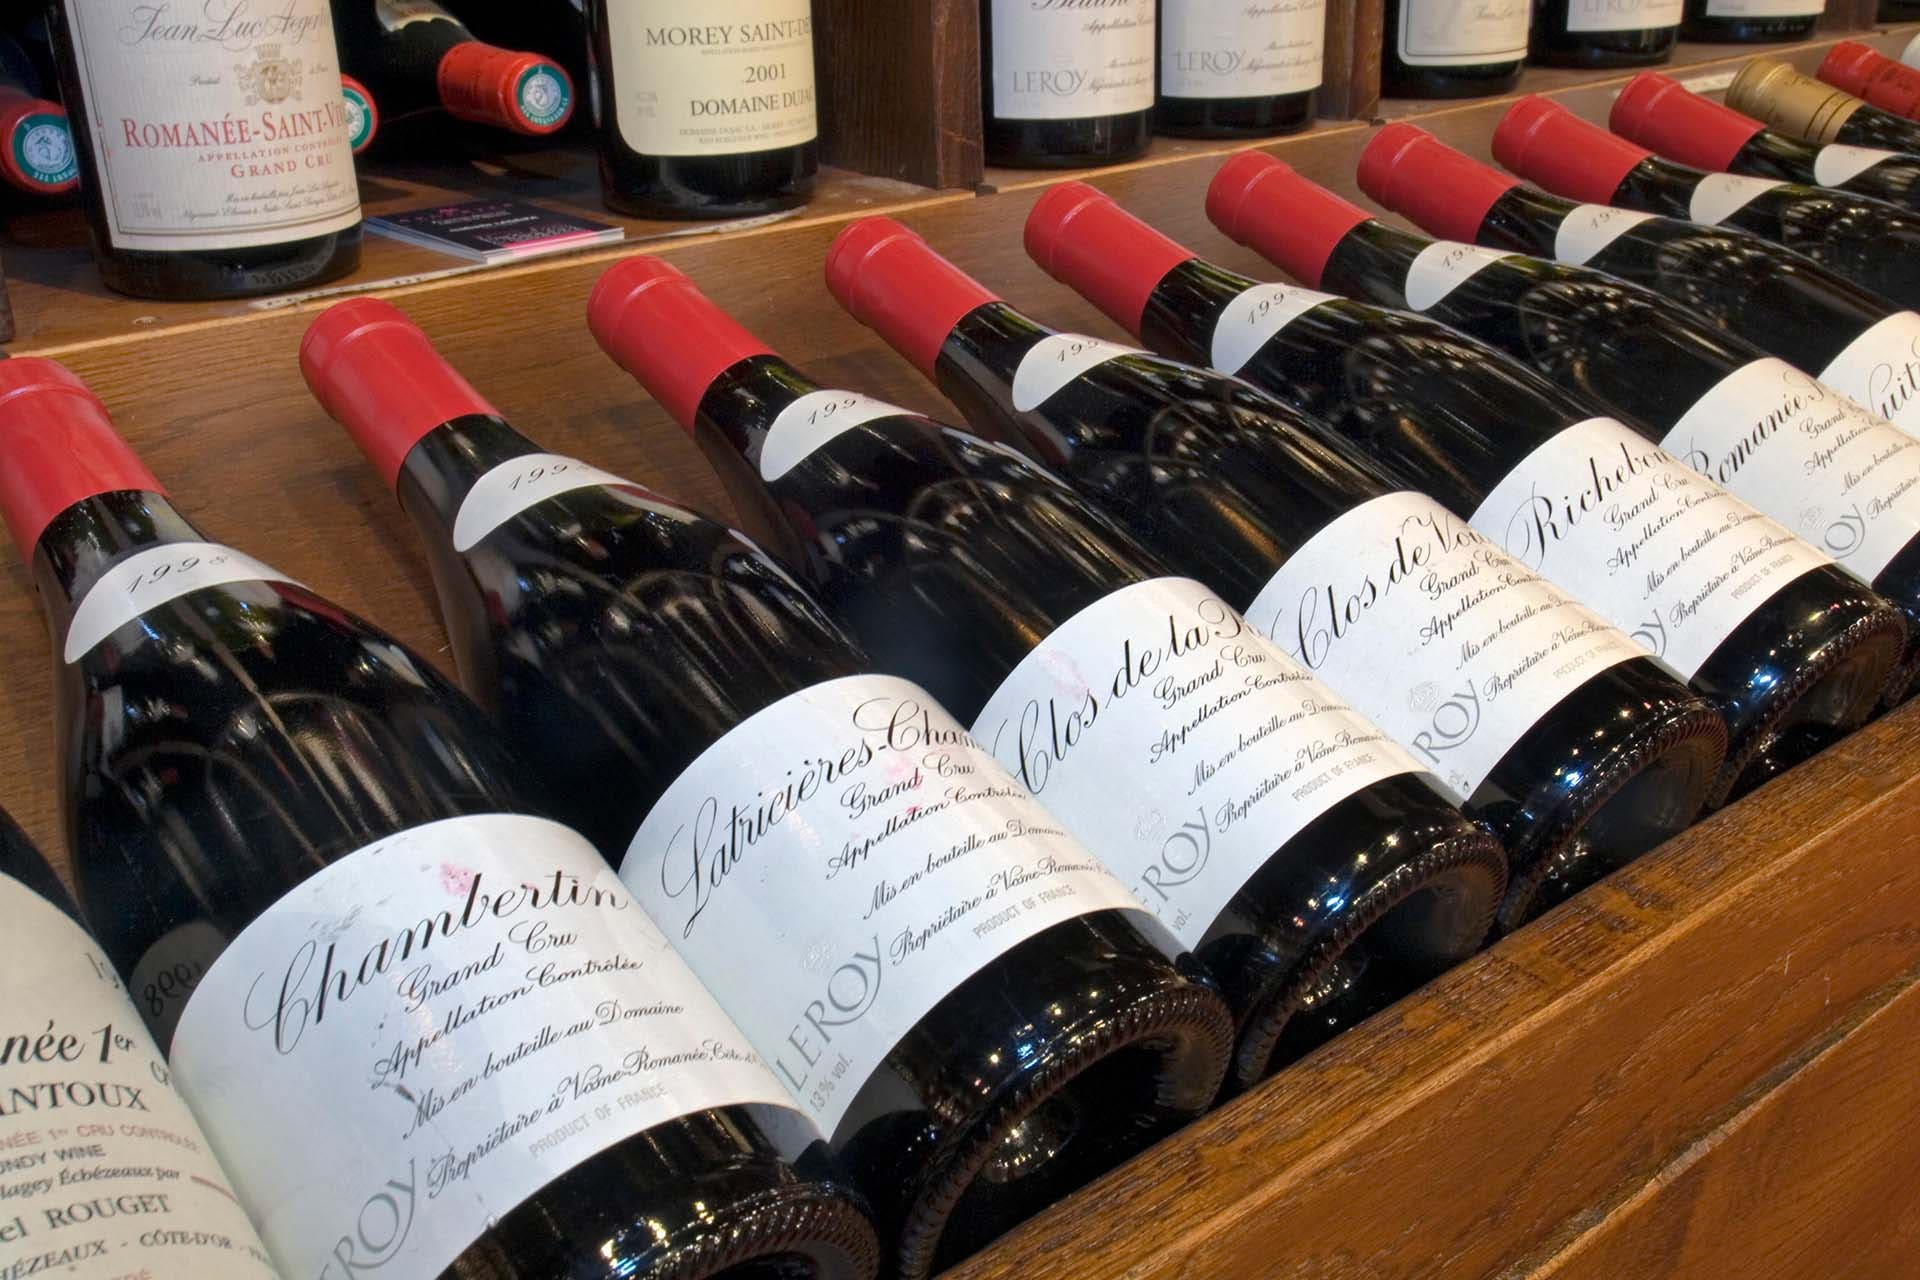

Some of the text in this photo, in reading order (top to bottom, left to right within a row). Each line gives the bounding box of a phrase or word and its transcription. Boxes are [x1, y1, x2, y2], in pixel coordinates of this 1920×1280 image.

[646, 25, 734, 46] MOREY
[1175, 50, 1246, 76] LEROY
[690, 93, 780, 116] DOMAINE
[743, 63, 786, 84] 2001
[1012, 69, 1088, 97] LEROY
[198, 146, 289, 162] APPELLATION
[230, 153, 333, 178] GRAND CRU
[1800, 408, 1847, 439] Grand
[1603, 488, 1658, 532] Grand
[1606, 507, 1683, 576] Appellation
[1419, 564, 1480, 601] Grand
[1643, 568, 1667, 600] Mis
[1666, 560, 1681, 577] en
[1679, 530, 1719, 564] bouteille
[1269, 574, 1377, 672] Clos
[1384, 537, 1430, 596] de
[1419, 584, 1502, 646] Appellation
[1668, 570, 1731, 628] Propriétaire
[1455, 643, 1481, 671] Mis
[1481, 636, 1499, 653] en
[1497, 604, 1541, 637] bouteille
[992, 688, 1100, 797] Clos
[1104, 638, 1166, 710] de
[1162, 614, 1212, 660] la
[1151, 644, 1267, 711] Grand Cru
[1483, 644, 1550, 703] Propriétaire
[1148, 686, 1252, 765] Appellation
[1187, 758, 1218, 797] Mis
[1217, 749, 1238, 769] en
[1237, 716, 1293, 751] bouteille
[1289, 710, 1306, 726] au
[840, 752, 976, 820] Grand Cru
[1214, 768, 1292, 834] Propriétaire
[1291, 774, 1333, 802] PRODUCT
[826, 801, 948, 880] Appellation
[862, 879, 899, 920] Mis
[898, 871, 924, 897] en
[924, 832, 987, 872] bouteille
[984, 829, 1009, 845] au
[888, 896, 983, 967] Propriétaire
[984, 882, 999, 900] à
[972, 883, 1077, 940] PRODUCT OF FRANCE
[243, 869, 629, 1056] Chambertin
[398, 920, 579, 1015] Grand Cru
[372, 956, 645, 1091] Appellation Contrôlée
[775, 933, 883, 1094] LEROY
[402, 1000, 685, 1140] Mis en bouteille au Domaine
[53, 1143, 108, 1162] WINE
[77, 1123, 115, 1139] CRU
[426, 1108, 543, 1200] Propriétaire
[544, 1091, 565, 1115] à
[527, 1080, 669, 1160] PRODUCT OF FRANCE
[44, 1193, 174, 1231] ROUGET
